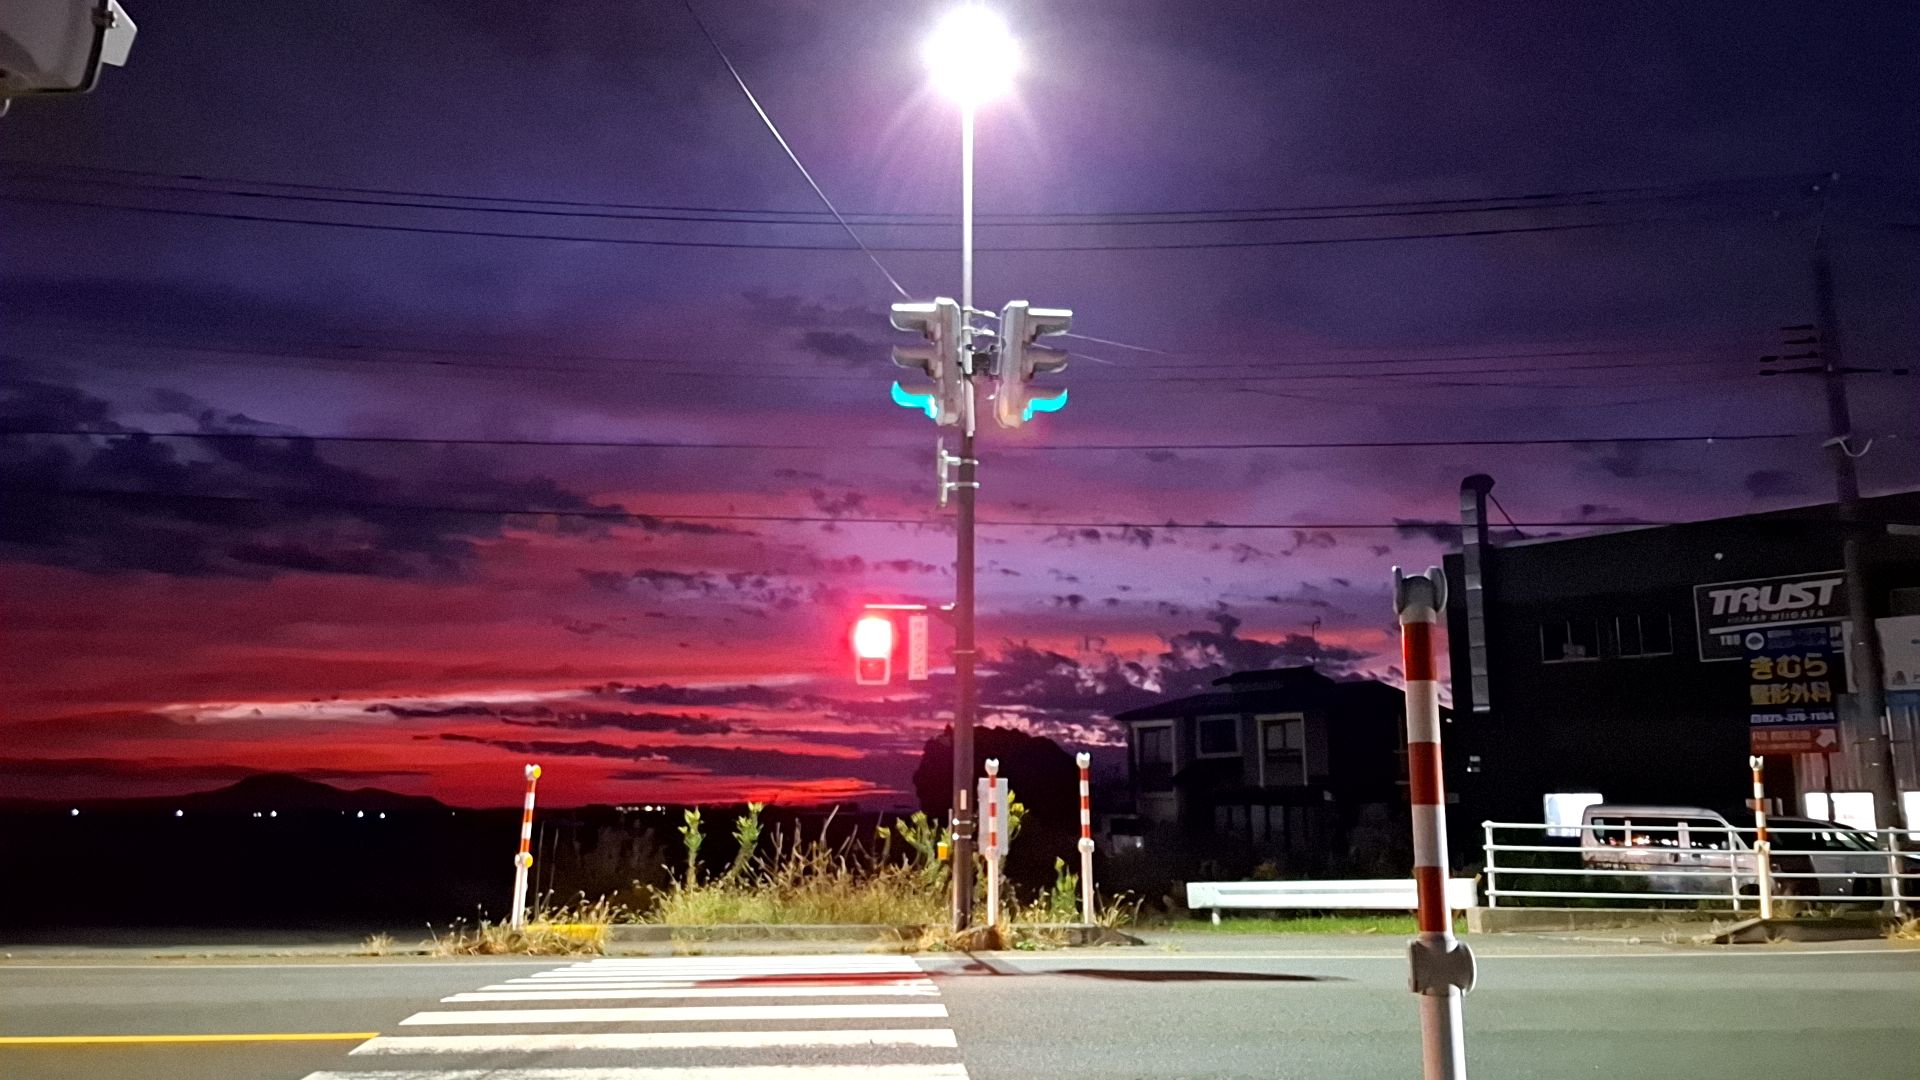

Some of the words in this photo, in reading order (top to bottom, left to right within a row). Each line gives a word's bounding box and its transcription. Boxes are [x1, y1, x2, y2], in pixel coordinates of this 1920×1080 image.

[1708, 577, 1843, 616] TRUST
[1749, 652, 1829, 681] きむら
